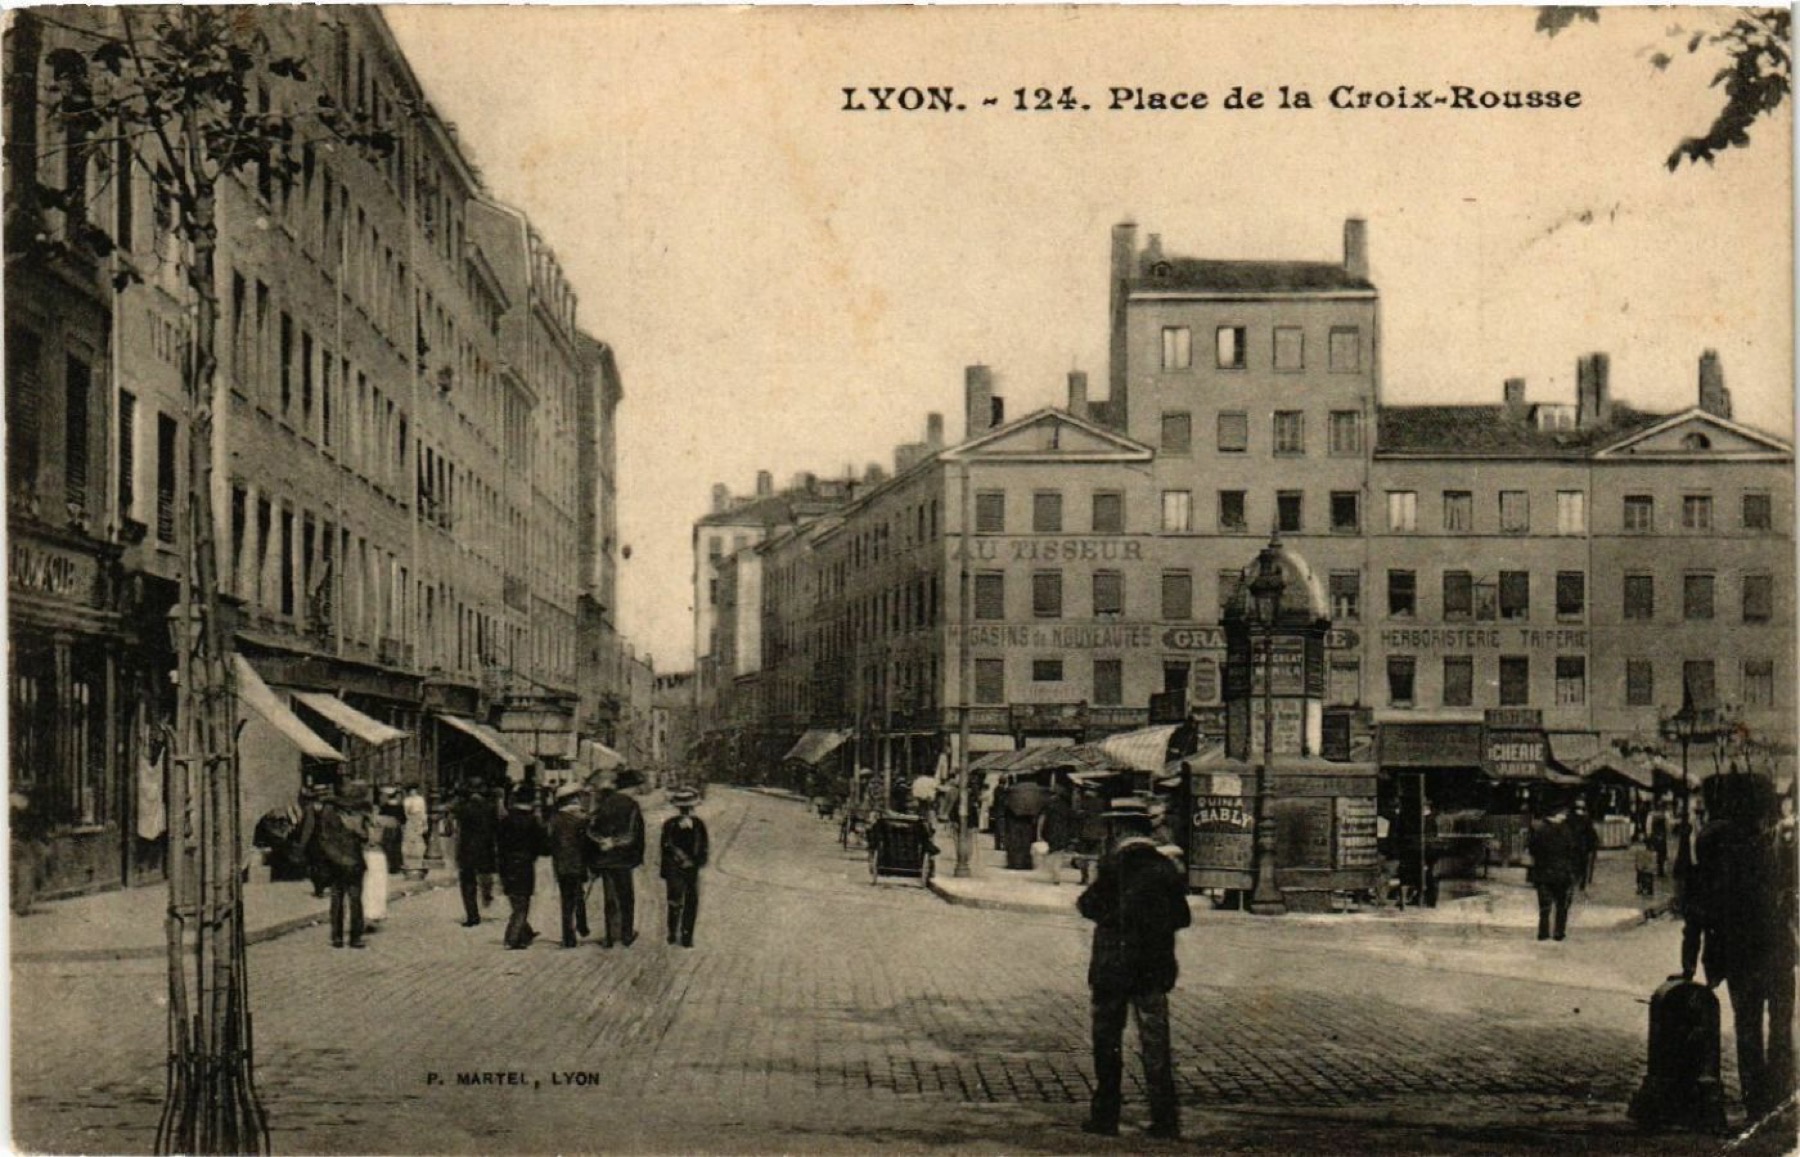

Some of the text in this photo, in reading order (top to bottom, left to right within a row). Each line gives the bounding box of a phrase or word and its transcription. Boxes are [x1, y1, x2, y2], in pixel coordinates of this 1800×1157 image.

[1011, 539, 1144, 561] TISSEUR
[947, 626, 1029, 649] MGASINS
[1381, 629, 1500, 648] HERBORISTERIE
[1520, 629, 1588, 648] TRIPERIE
[1197, 796, 1244, 807] QUINA
